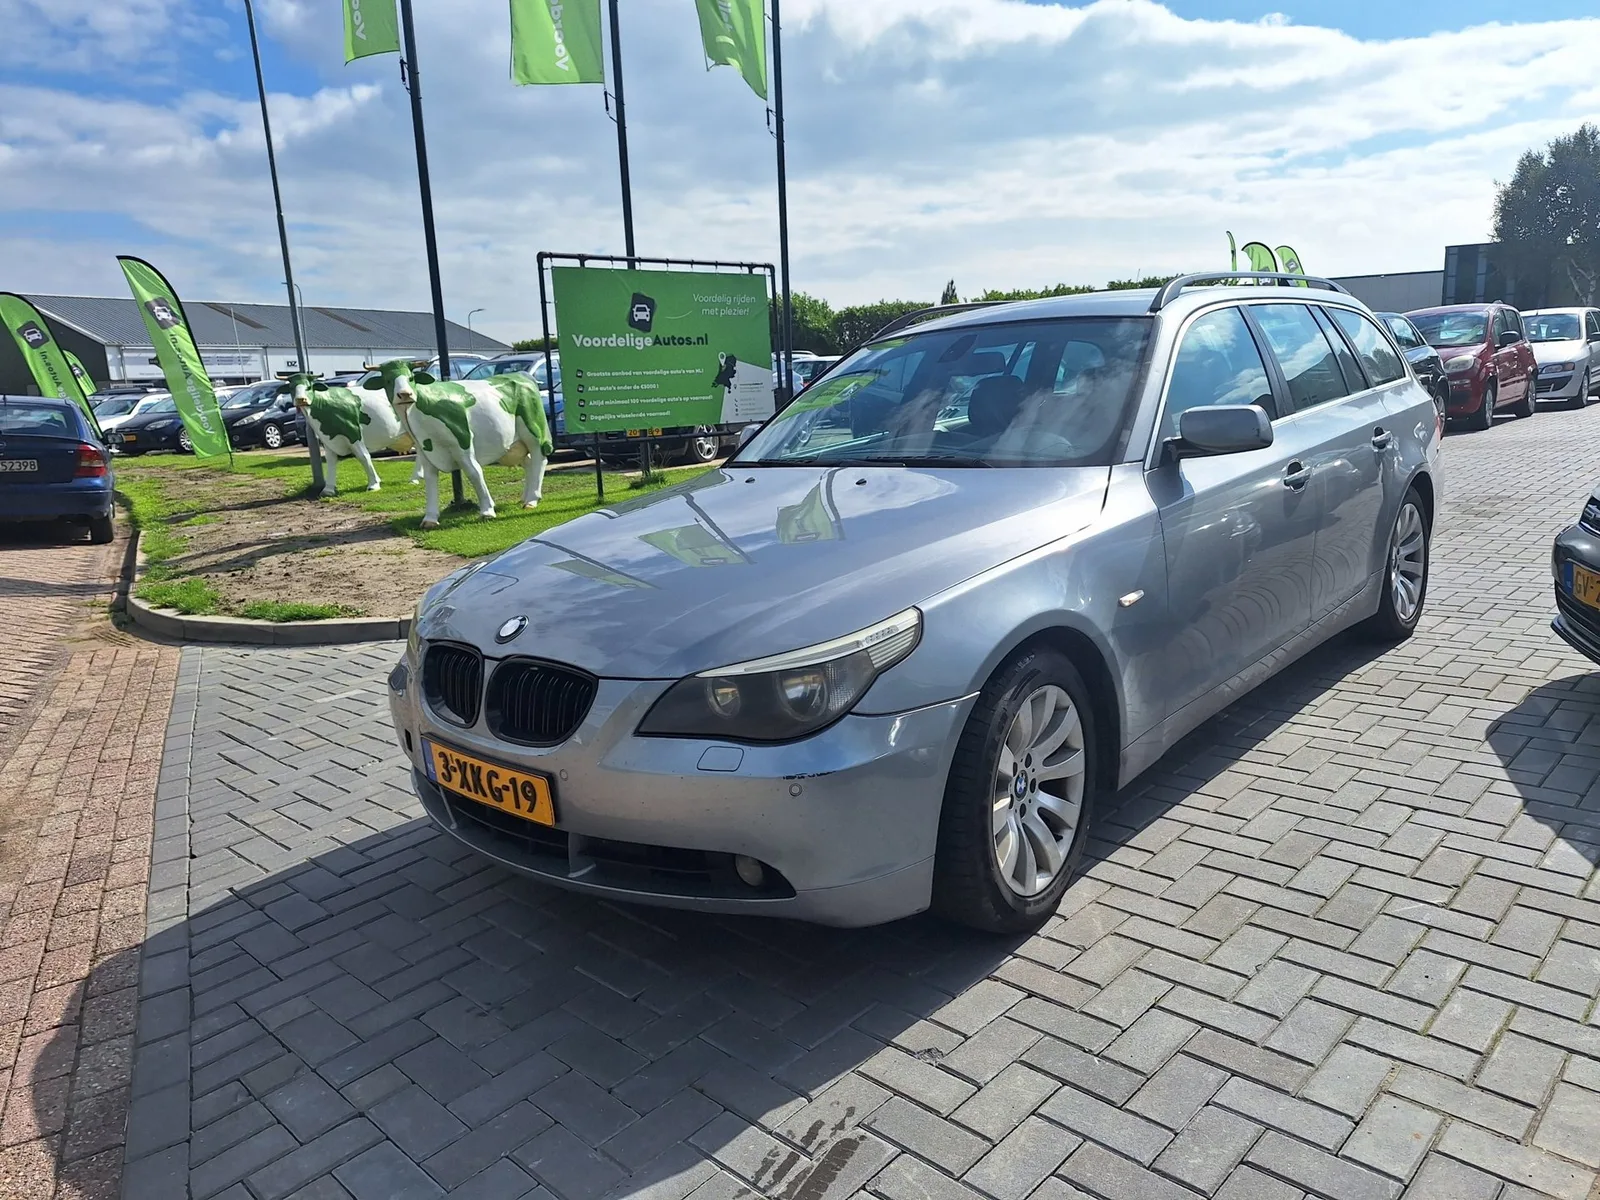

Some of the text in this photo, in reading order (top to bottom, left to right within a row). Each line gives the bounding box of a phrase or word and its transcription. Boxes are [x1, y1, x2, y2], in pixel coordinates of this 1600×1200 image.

[692, 293, 756, 306] Voordelig rijden
[701, 306, 750, 318] met plezier!
[572, 333, 709, 350] VoordeligeAutos.nl
[643, 368, 670, 377] voordelige
[670, 367, 686, 375] auto's
[617, 383, 632, 391] onder
[589, 400, 605, 408] Altijd
[605, 398, 630, 406] minimaal
[640, 397, 667, 406] voordelige
[667, 395, 683, 403] auto's
[438, 751, 537, 813] 3-XKG-19
